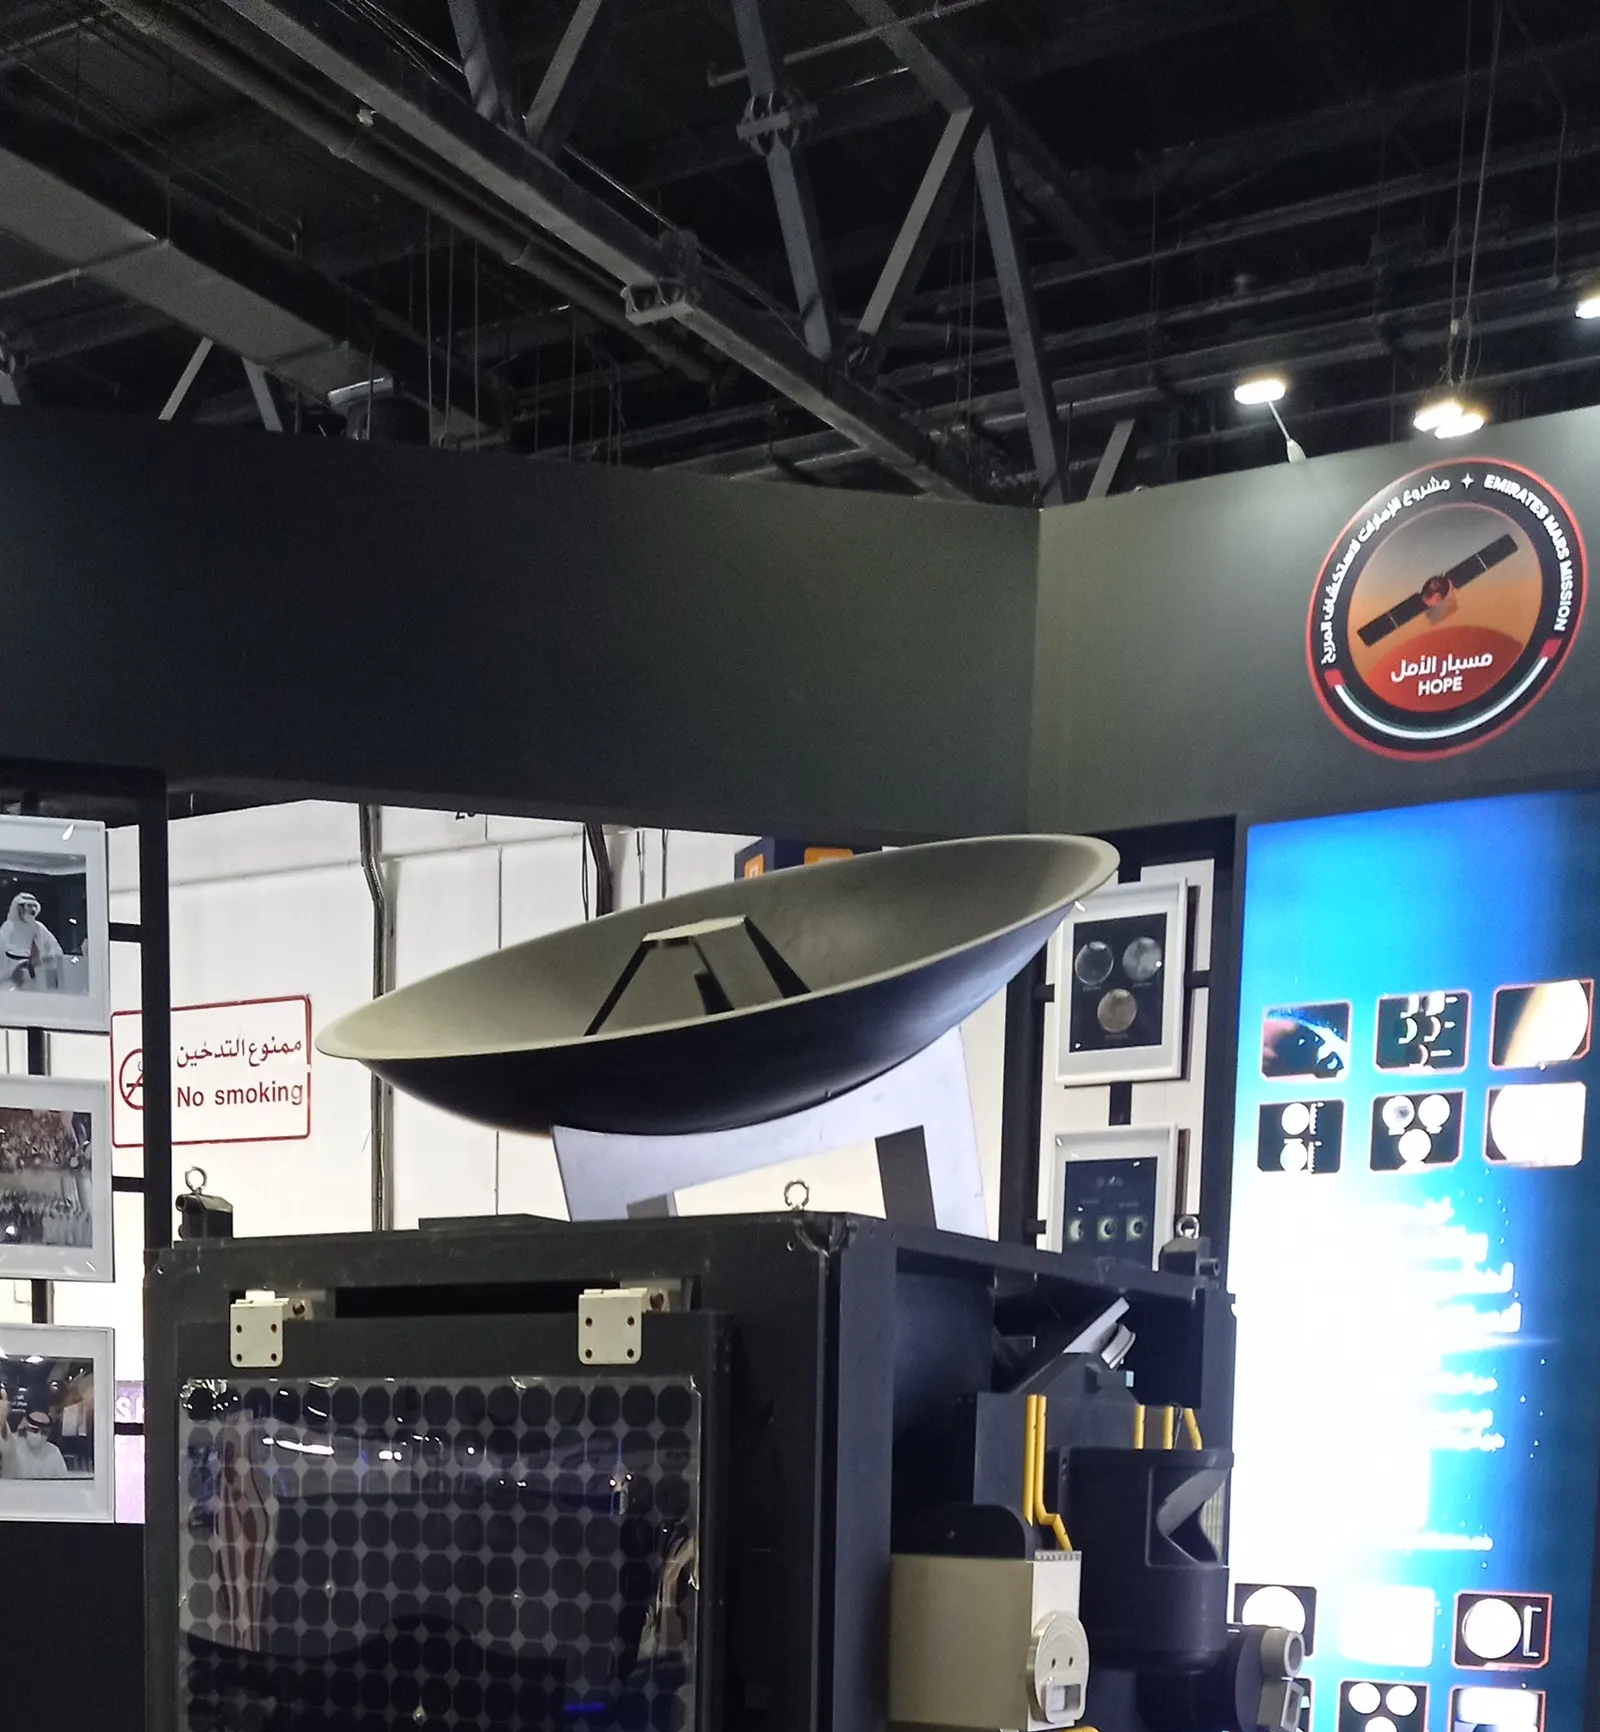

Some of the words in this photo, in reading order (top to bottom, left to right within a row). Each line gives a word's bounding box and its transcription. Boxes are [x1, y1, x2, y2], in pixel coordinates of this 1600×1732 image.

[1403, 476, 1451, 507] مشروع
[1483, 474, 1549, 520] EMIRATES
[1542, 514, 1570, 560] MARS
[1323, 538, 1361, 620] لاستكشاف
[1554, 560, 1573, 632] MISSION
[1321, 621, 1336, 665] المريخ
[1391, 655, 1437, 682] الأمل
[1440, 652, 1493, 677] مسبار
[1418, 676, 1463, 696] HOPE
[176, 1038, 245, 1068] التدخين
[248, 1036, 302, 1067] ممنوع
[177, 1086, 204, 1107] No
[214, 1080, 303, 1106] smoking
